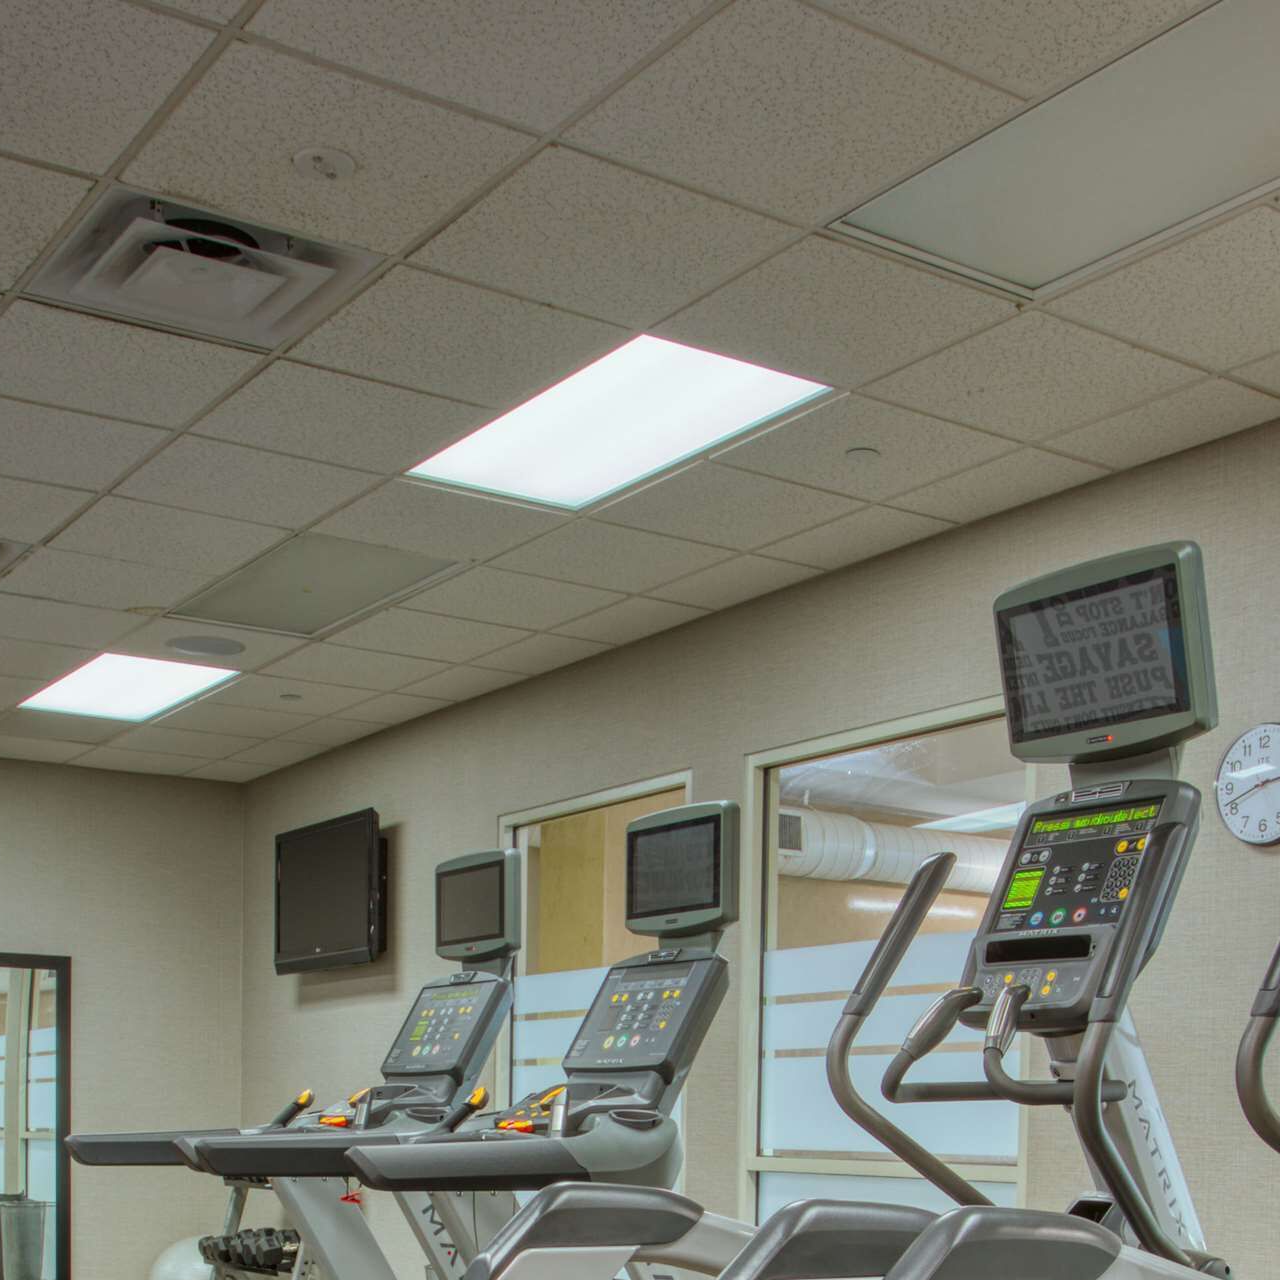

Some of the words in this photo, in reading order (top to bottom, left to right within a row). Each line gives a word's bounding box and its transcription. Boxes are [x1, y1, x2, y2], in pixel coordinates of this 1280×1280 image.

[1259, 735, 1271, 749] 12
[1243, 744, 1252, 757] 11
[1230, 760, 1242, 773] 10
[1225, 782, 1234, 795] 9
[1229, 802, 1239, 816] 8
[1241, 815, 1250, 829] 7
[1258, 819, 1267, 832] 6
[1127, 1079, 1190, 1236] MATRIX
